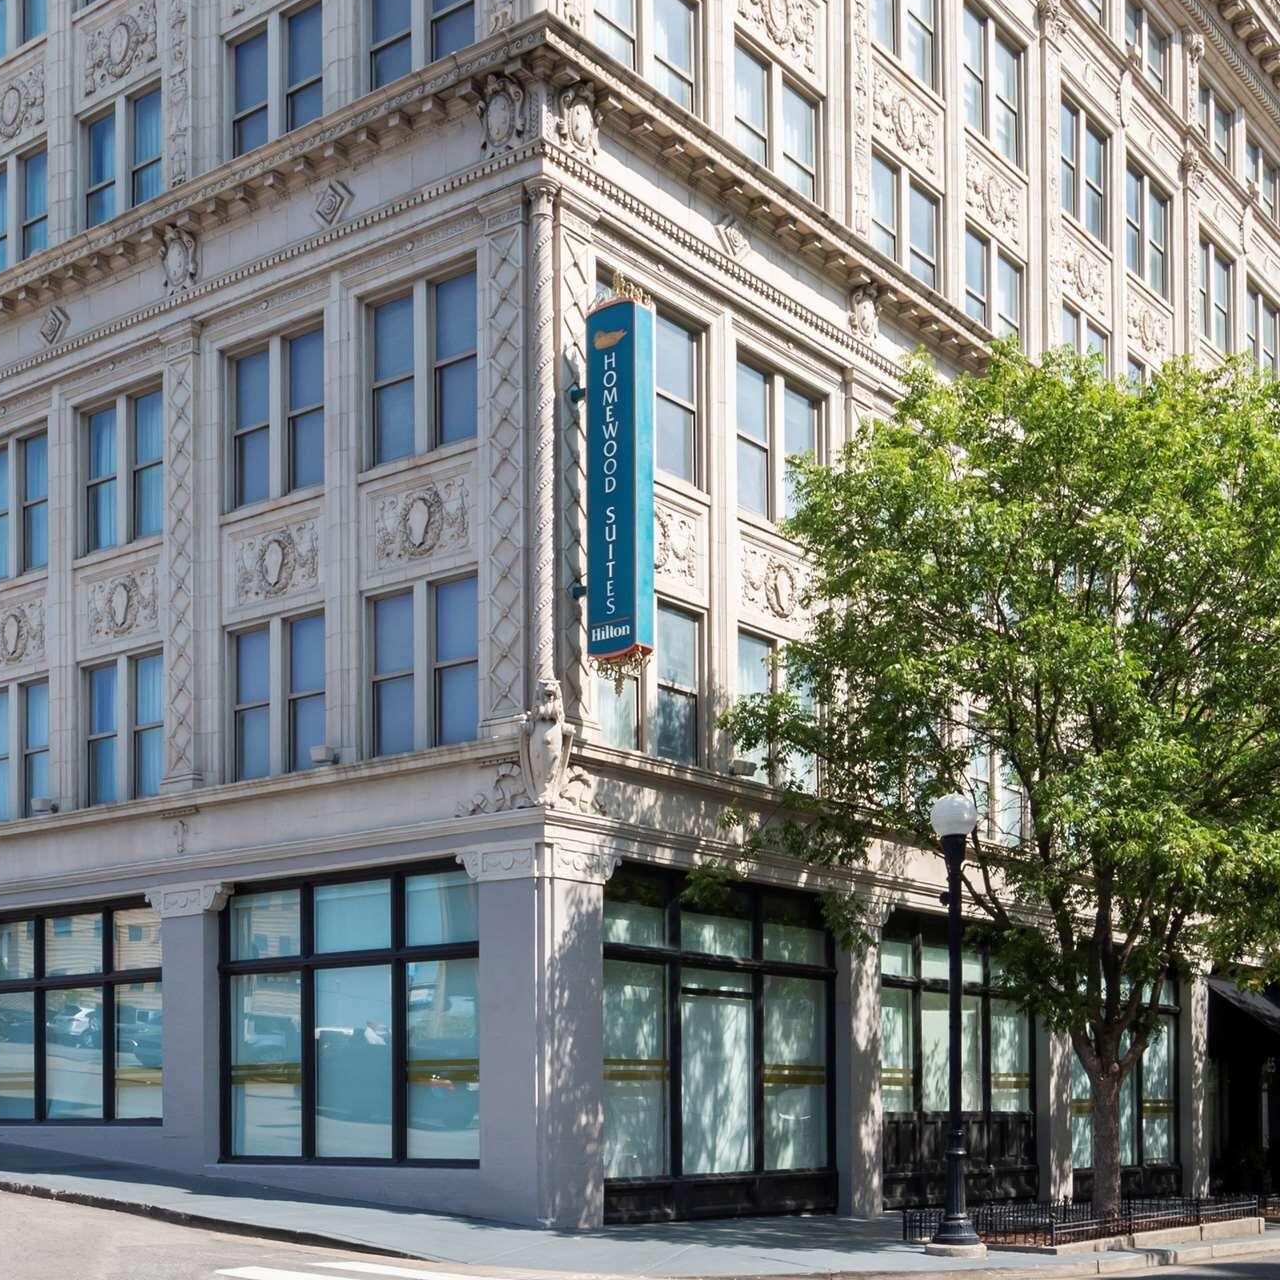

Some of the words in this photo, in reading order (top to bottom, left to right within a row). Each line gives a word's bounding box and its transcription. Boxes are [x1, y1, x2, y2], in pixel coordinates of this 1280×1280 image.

[602, 352, 619, 494] HOMEWOOD
[604, 506, 617, 615] SUITES
[591, 624, 631, 642] Hilton
